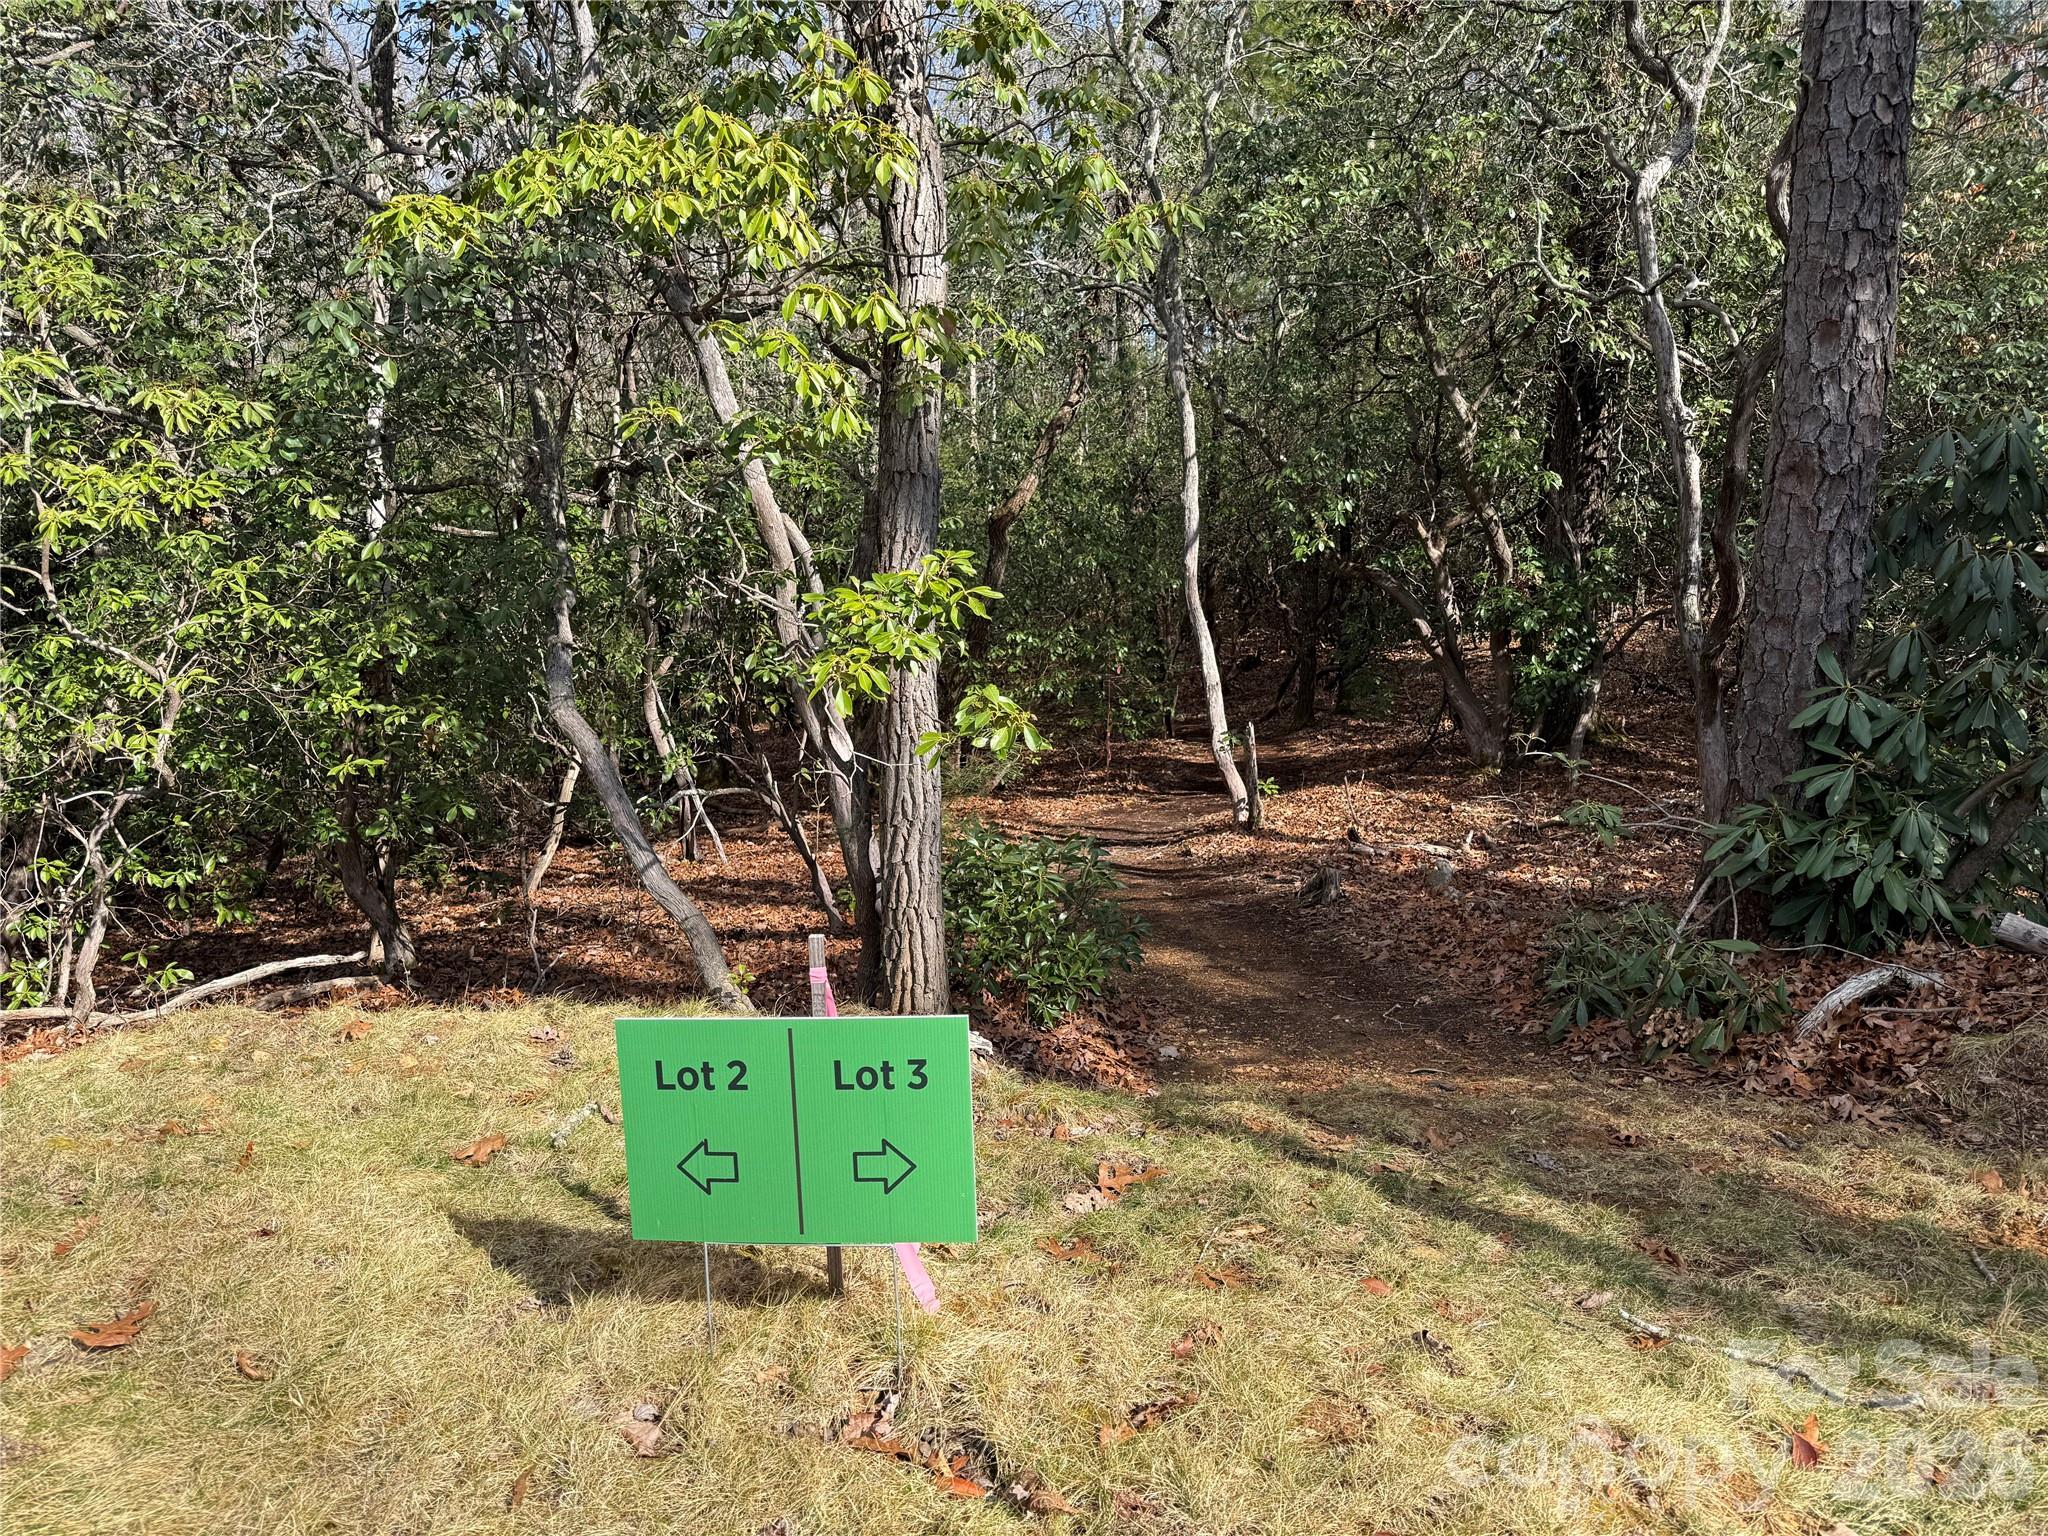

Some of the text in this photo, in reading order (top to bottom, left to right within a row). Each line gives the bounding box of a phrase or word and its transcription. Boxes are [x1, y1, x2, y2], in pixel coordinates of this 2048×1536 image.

[655, 1060, 749, 1091] Lot 2
[833, 1058, 930, 1091] Lot 3
